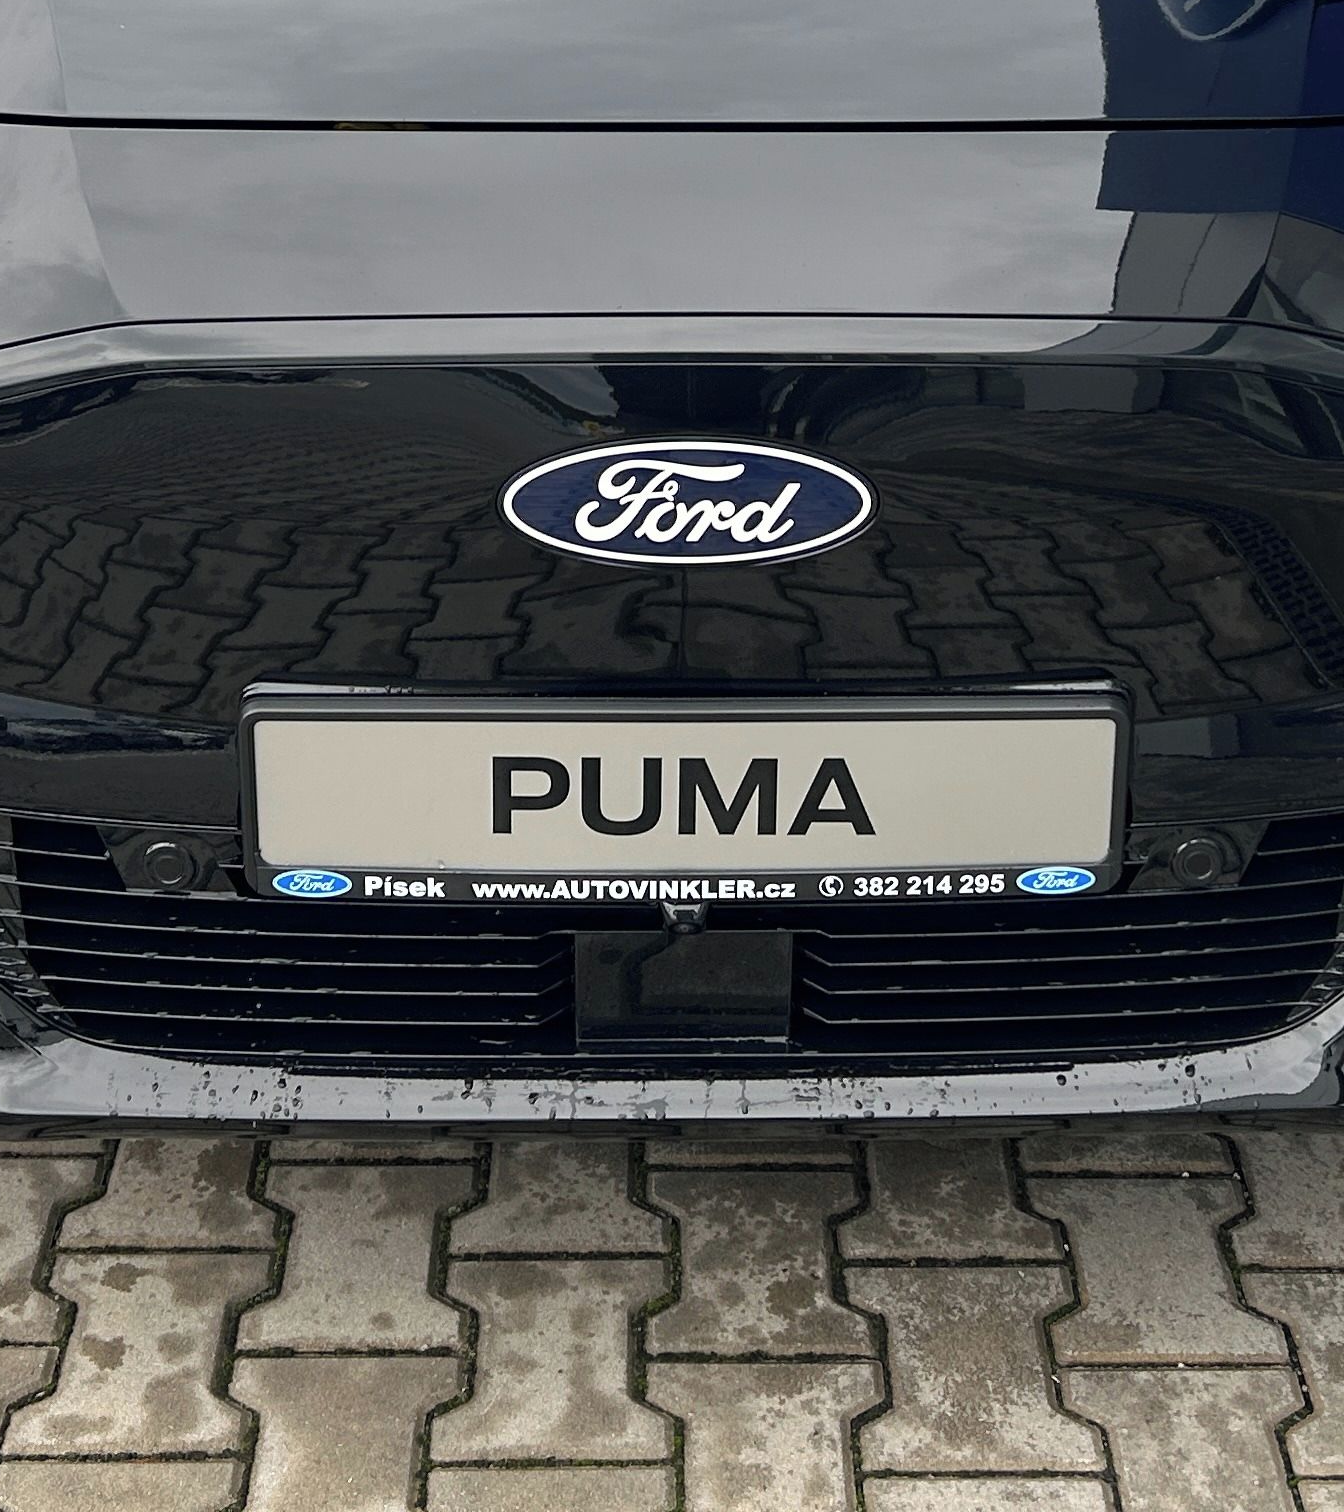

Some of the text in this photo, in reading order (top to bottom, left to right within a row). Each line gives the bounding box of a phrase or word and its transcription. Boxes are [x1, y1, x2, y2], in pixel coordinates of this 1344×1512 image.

[574, 459, 801, 543] Ford
[492, 756, 877, 836] PUMA
[364, 875, 446, 898] Písek
[471, 878, 796, 900] www.AUTOVINKLER.cz
[853, 876, 899, 897] 382
[905, 875, 953, 896] 214
[958, 873, 1006, 895] 295
